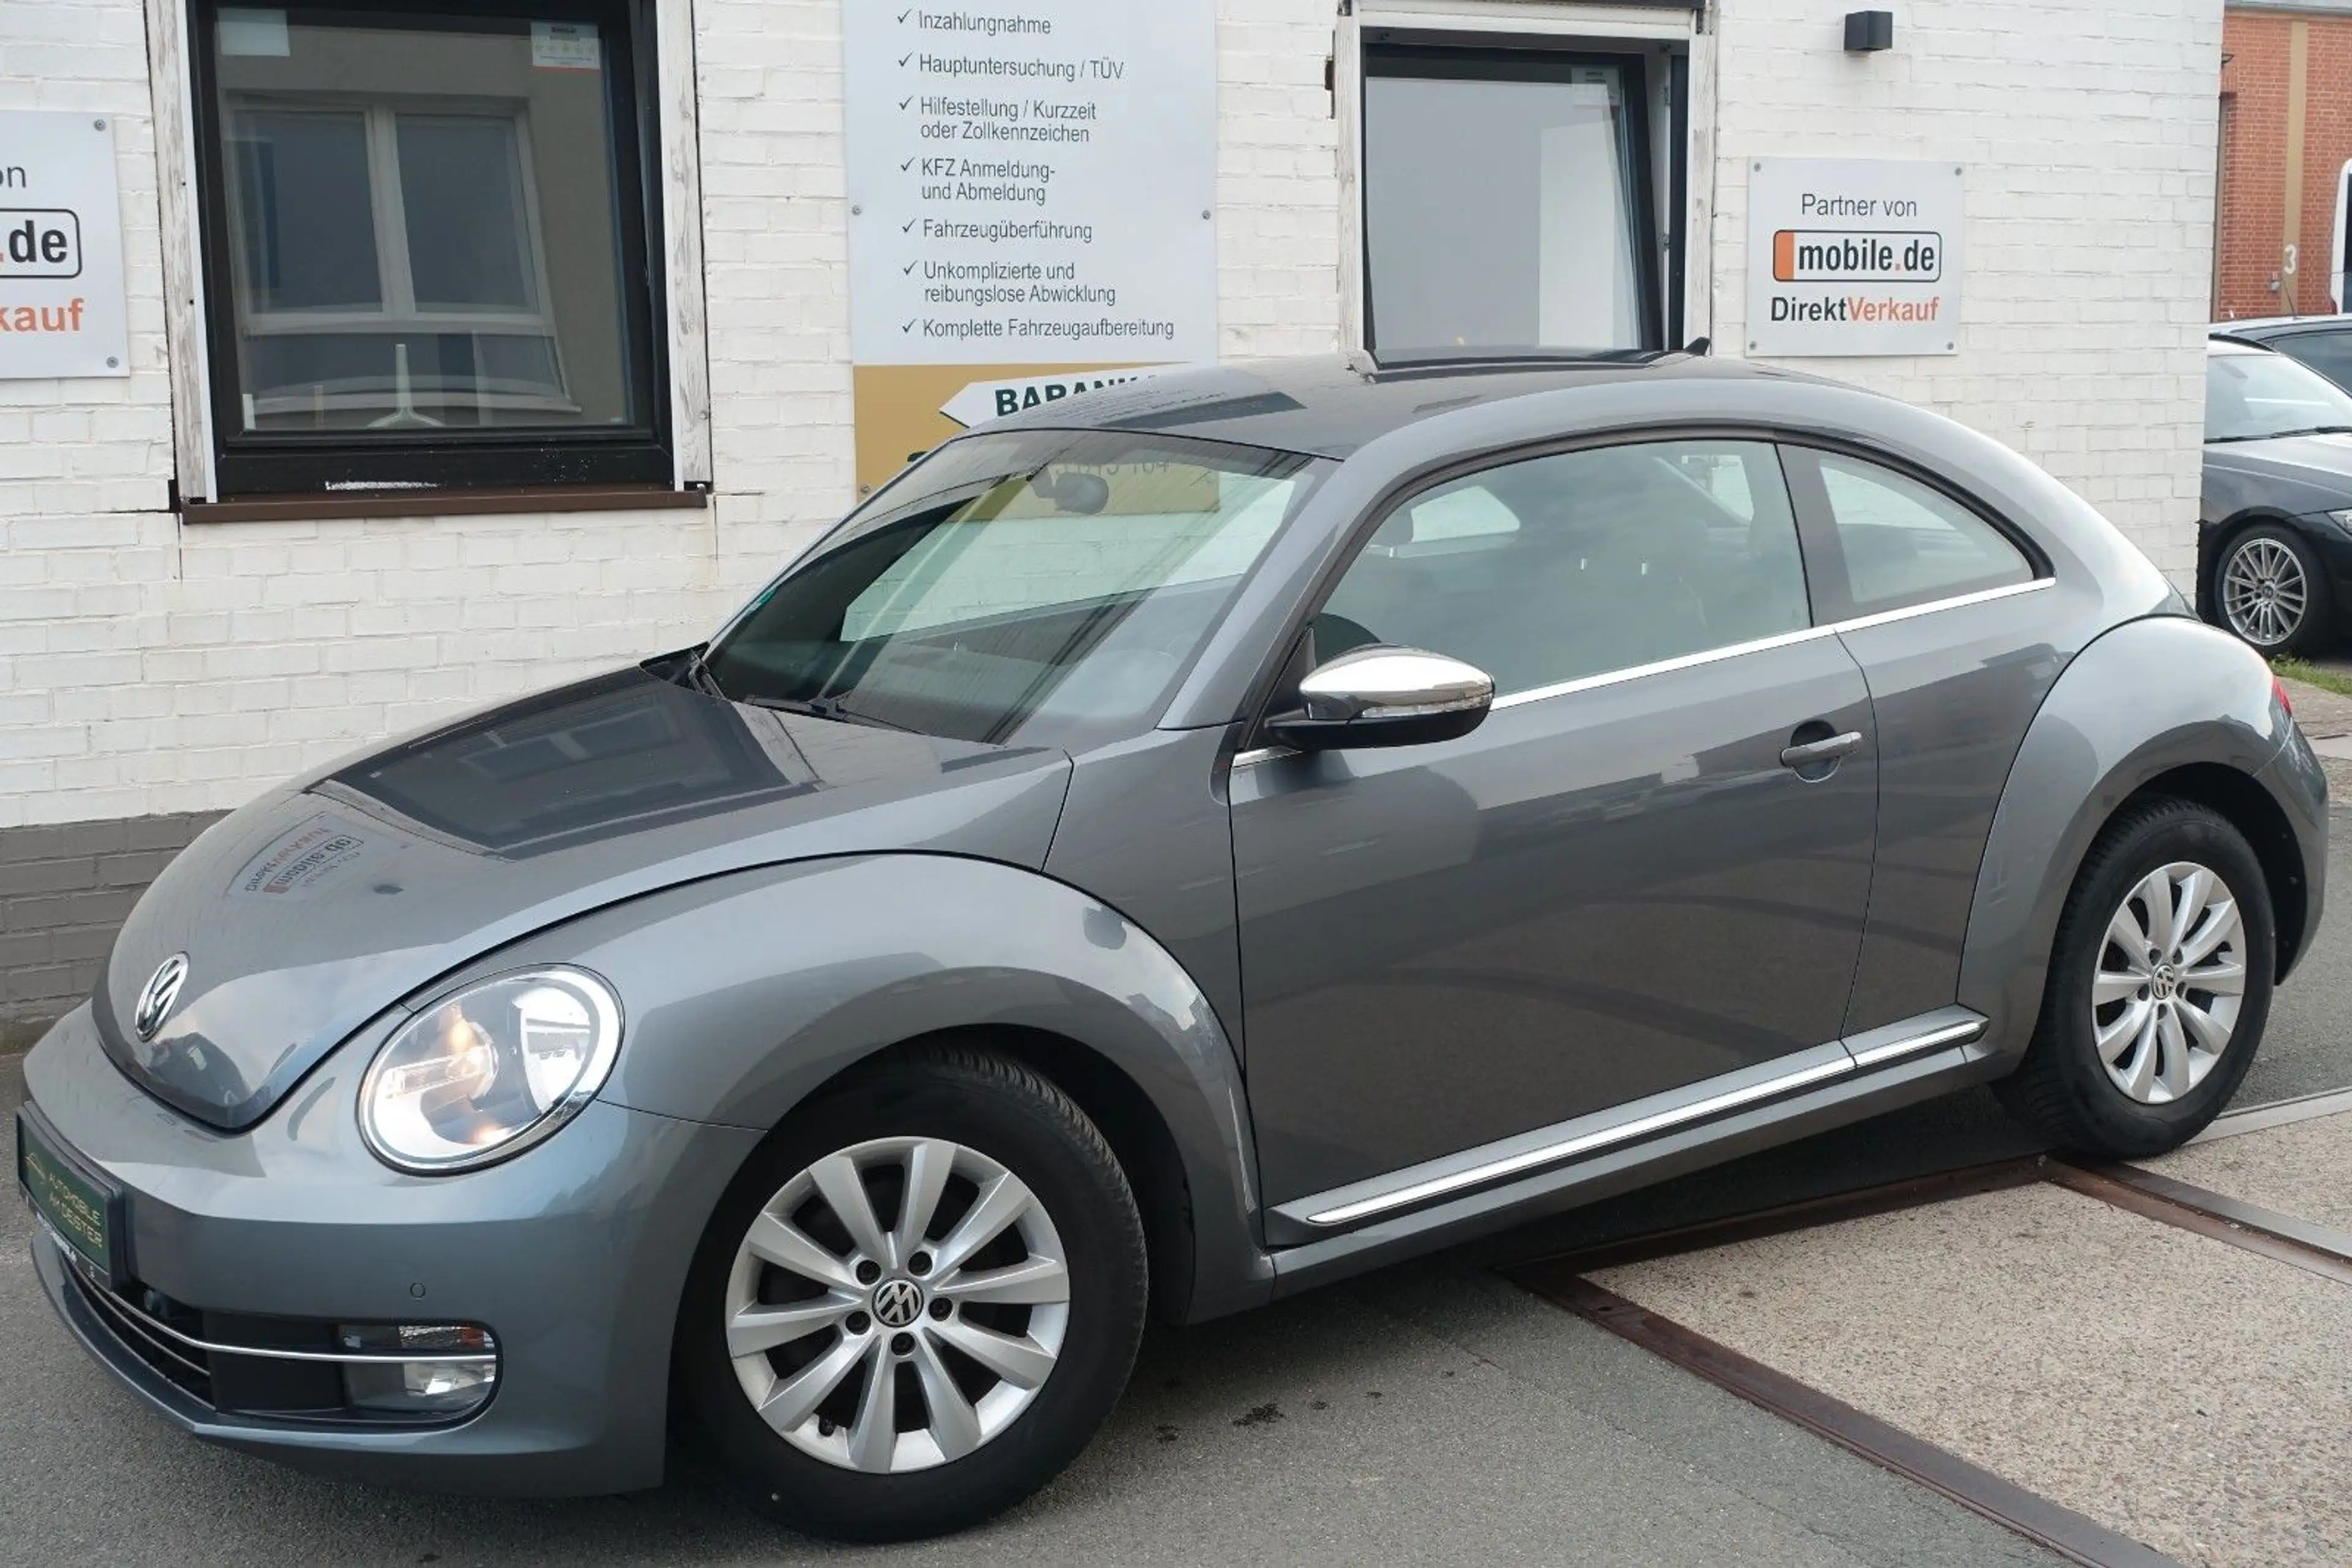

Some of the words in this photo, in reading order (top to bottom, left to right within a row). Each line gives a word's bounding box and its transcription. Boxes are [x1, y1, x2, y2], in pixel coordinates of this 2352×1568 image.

[919, 10, 1051, 36] Inzahlungnahme
[920, 54, 1075, 81] Hauptuntersuchung
[1090, 57, 1124, 79] TÜV
[921, 97, 1019, 120] Hilfestellung
[1034, 100, 1097, 120] Kurzzeit
[921, 121, 958, 139] oder
[963, 121, 1089, 142] Zollkennzeichen
[0, 167, 27, 188] n
[922, 158, 956, 177] KFZ
[960, 159, 1055, 183] Anmeldung-
[922, 183, 951, 200] und
[956, 183, 1046, 205] Abmeldung
[1802, 194, 1877, 216] Partner
[1883, 201, 1917, 217] von
[924, 219, 1092, 244] Fahrzeugüberführung
[1799, 238, 1935, 271] mobile.de
[2284, 243, 2297, 274] 3
[925, 261, 1042, 283] Unkomplizierte
[1047, 262, 1074, 281] und
[925, 284, 1025, 306] reibungslose
[1029, 285, 1116, 306] Abwicklung
[1771, 296, 1940, 322] DirektVerkauf
[923, 318, 1003, 339] Komplette
[1009, 318, 1174, 341] Fahrzeugaufbereitung
